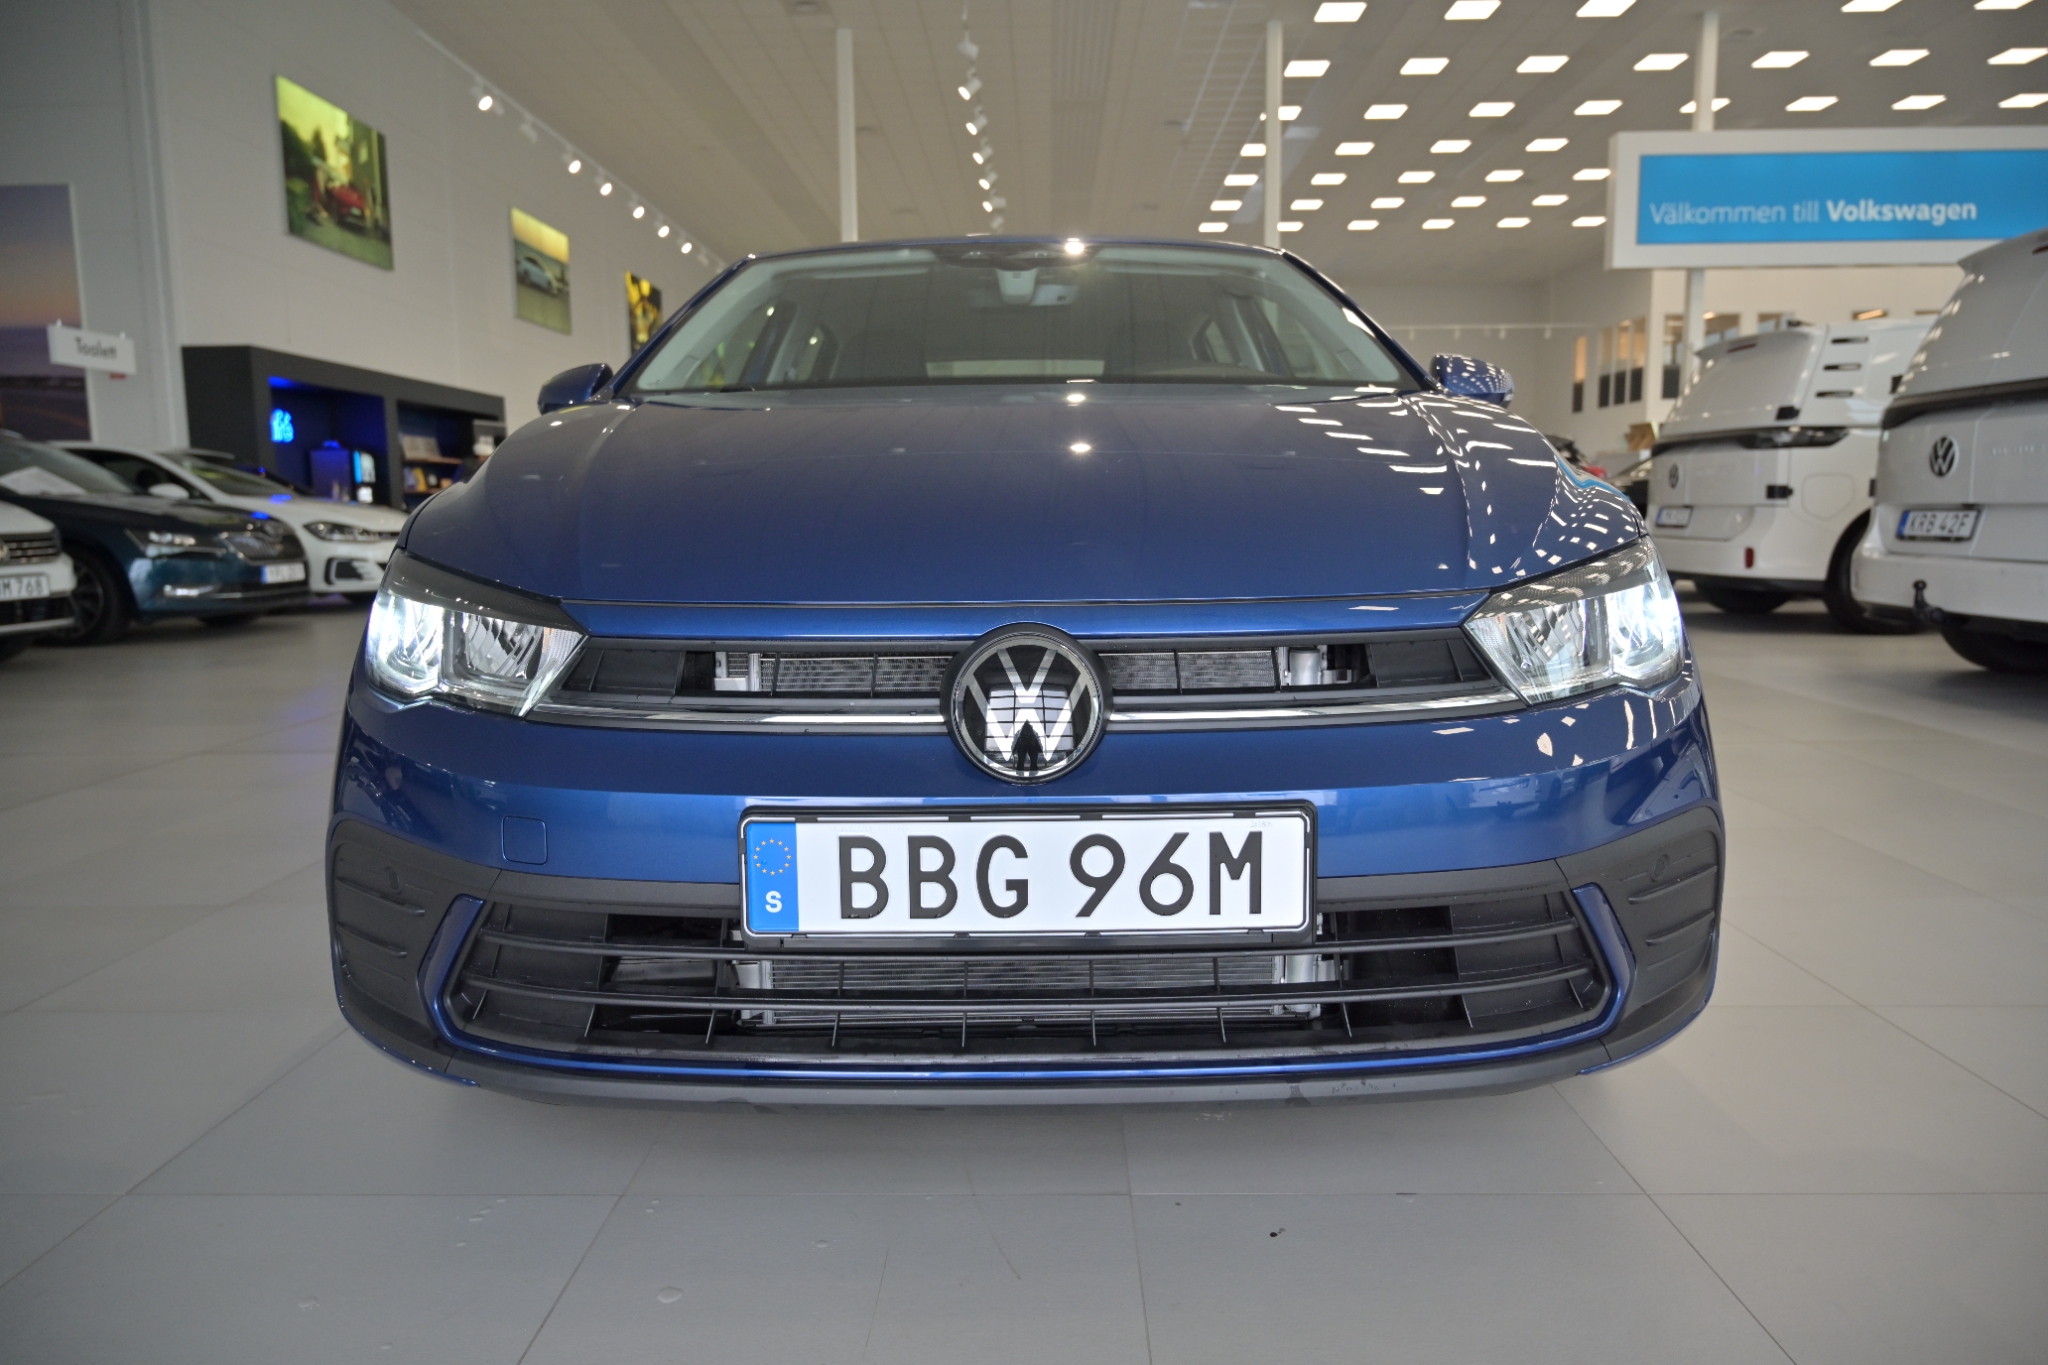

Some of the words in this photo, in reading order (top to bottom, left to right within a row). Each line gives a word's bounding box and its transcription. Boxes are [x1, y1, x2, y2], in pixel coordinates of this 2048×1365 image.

[1650, 201, 1786, 225] Välkommen
[1793, 200, 1820, 223] till
[1826, 198, 1977, 226] Volkswagen
[1939, 513, 1970, 533] 42F
[765, 890, 782, 913] S
[838, 834, 1029, 919] BBG
[1069, 831, 1263, 918] 96M
